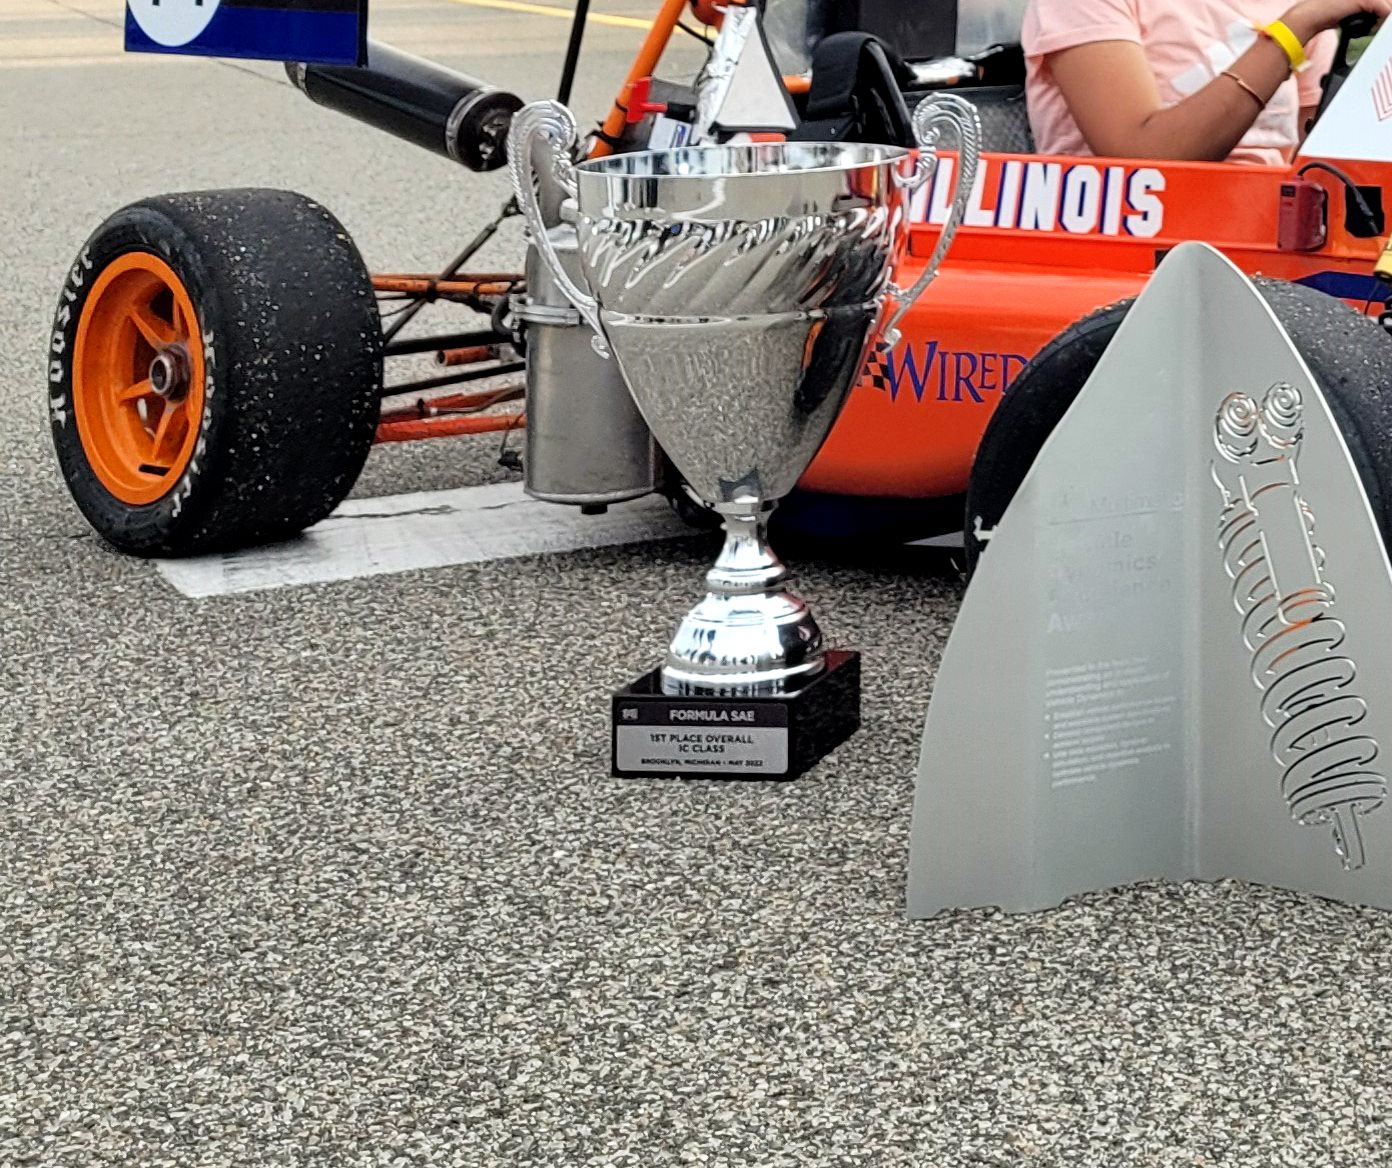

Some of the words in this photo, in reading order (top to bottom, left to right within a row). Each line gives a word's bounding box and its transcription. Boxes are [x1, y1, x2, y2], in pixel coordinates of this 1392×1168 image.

[669, 709, 729, 722] FORMULA
[730, 710, 755, 722] SAE
[650, 734, 666, 744] 1ST
[669, 734, 702, 744] PLACE
[705, 734, 754, 744] OVERALL
[692, 744, 725, 754] CLASS
